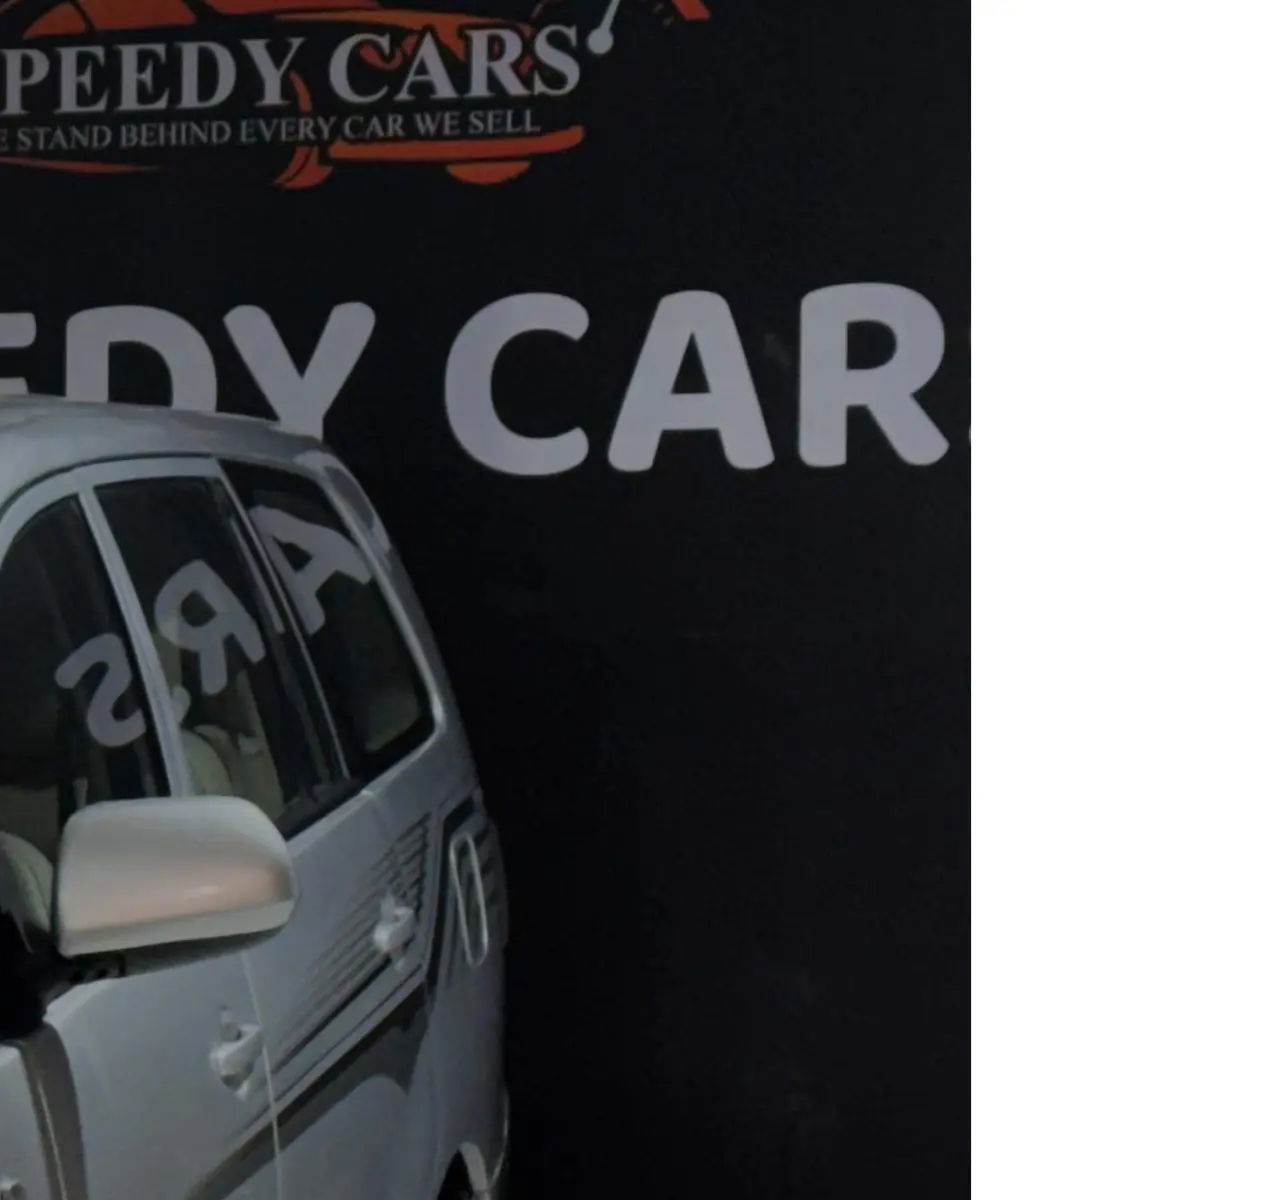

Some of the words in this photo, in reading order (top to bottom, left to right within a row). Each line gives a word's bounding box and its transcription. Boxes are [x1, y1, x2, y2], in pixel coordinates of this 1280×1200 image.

[328, 23, 581, 104] CARS
[16, 123, 112, 152] STAND
[120, 119, 231, 149] BEHIND
[240, 116, 337, 144] EVERY
[344, 113, 404, 141] CAR
[413, 109, 460, 136] WE
[468, 107, 542, 134] SELL
[444, 281, 971, 476] CAR
